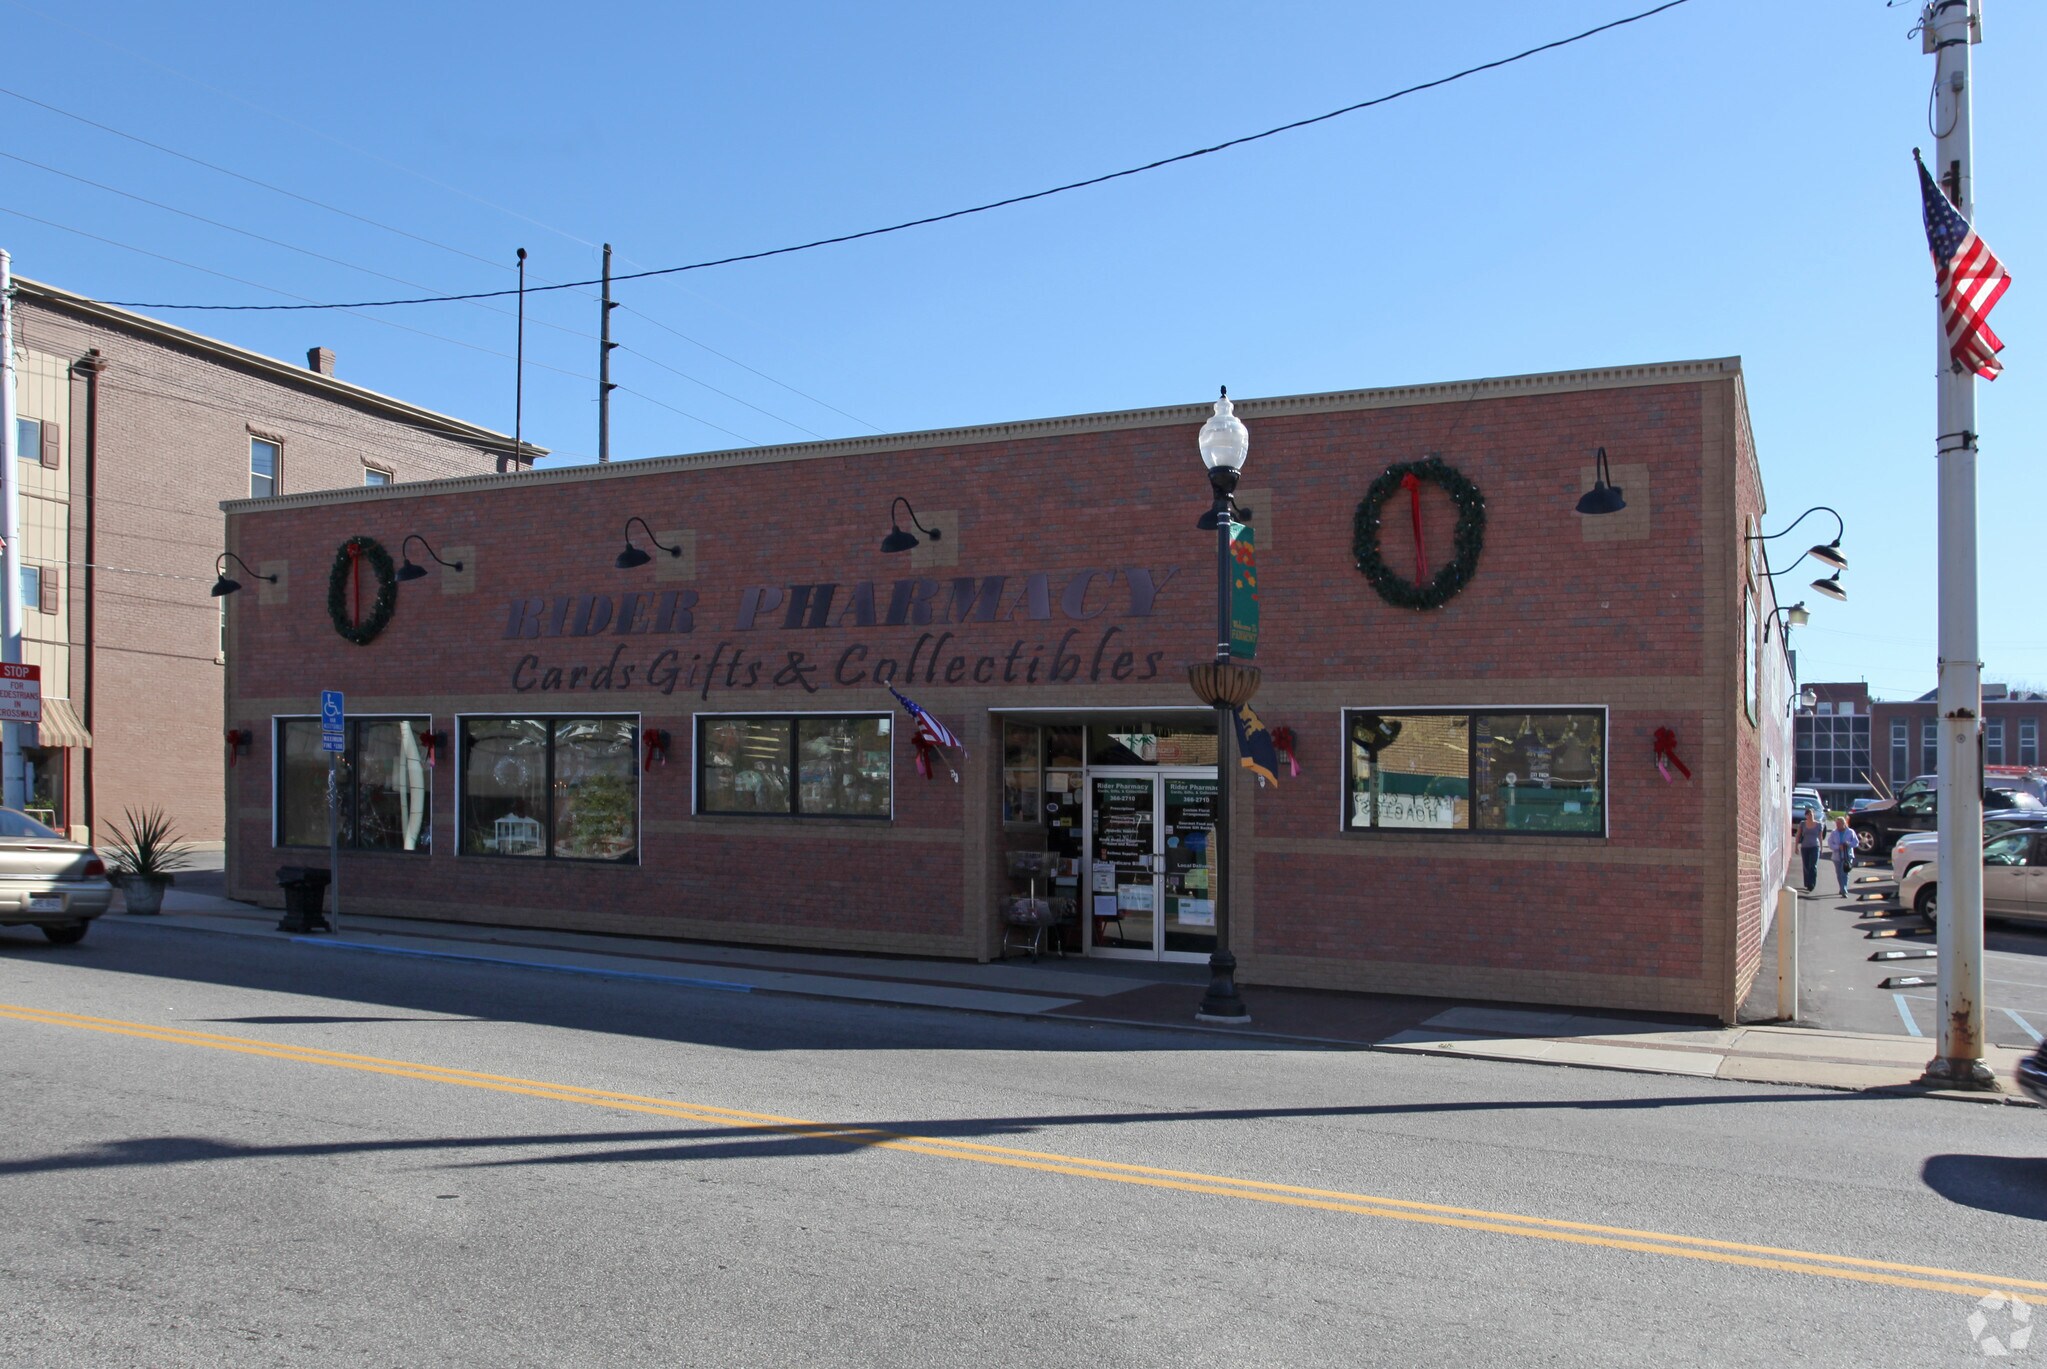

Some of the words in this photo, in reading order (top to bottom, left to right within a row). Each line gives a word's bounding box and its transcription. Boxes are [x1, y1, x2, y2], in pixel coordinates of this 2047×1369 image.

[504, 589, 699, 640] RIDER
[732, 566, 1180, 632] PHARMACY
[512, 643, 636, 692] Cards
[647, 641, 762, 701] Gifts
[772, 651, 819, 694] &
[835, 626, 1164, 686] Collectibles
[4, 665, 29, 678] STOP
[10, 681, 24, 690] FOR
[0, 690, 39, 700] EDESTRIANS
[14, 700, 21, 708] IN
[0, 708, 38, 719] ROSSWALK
